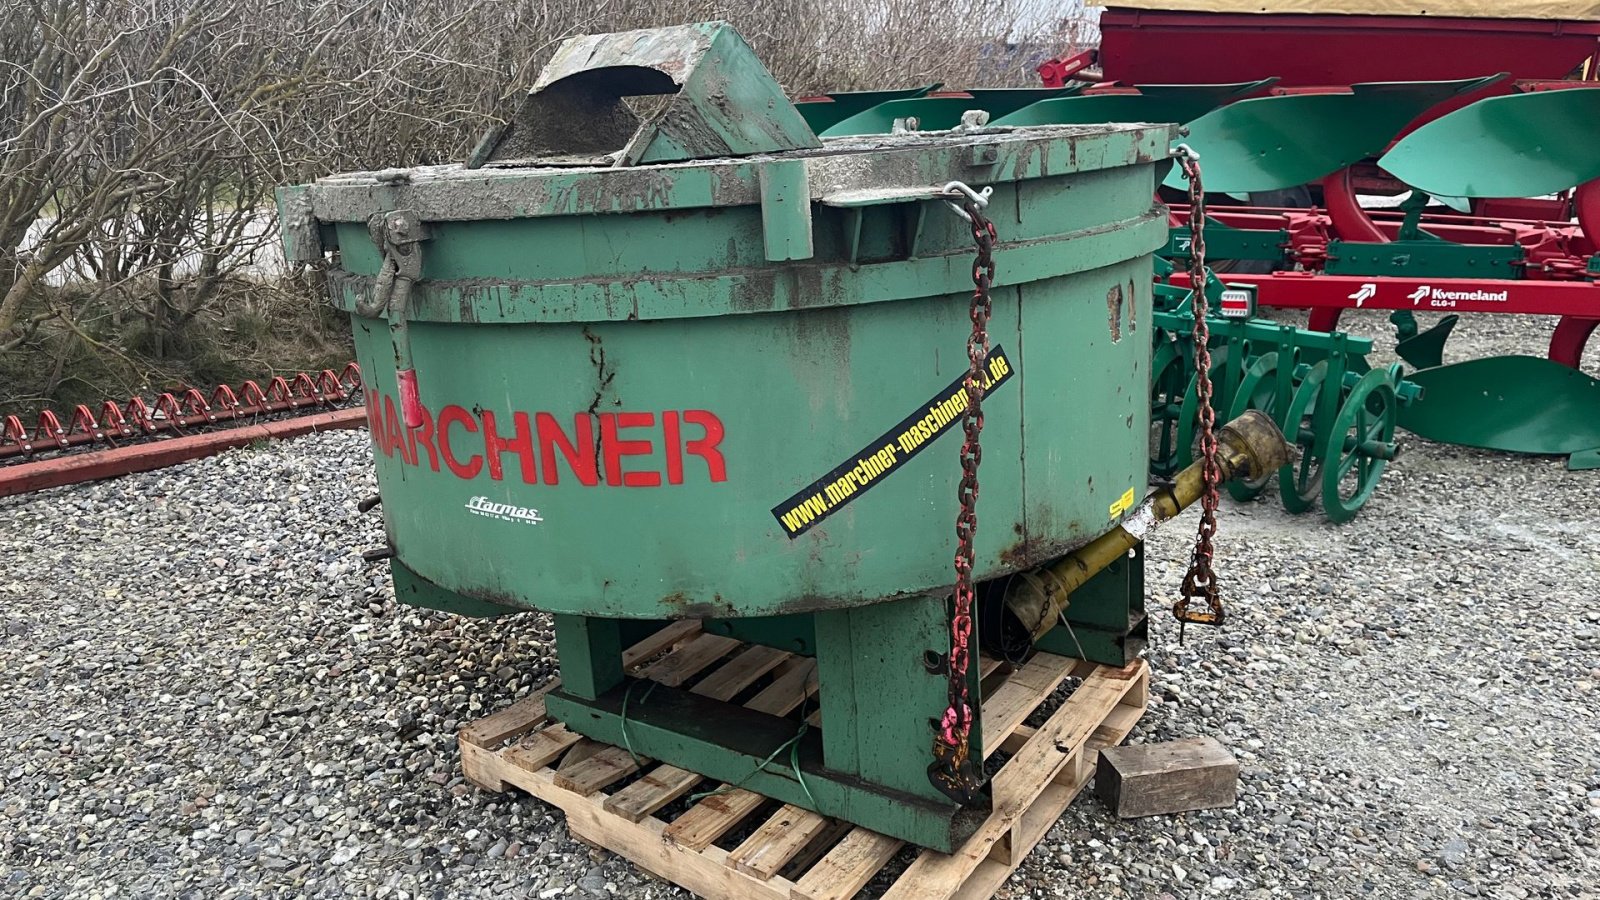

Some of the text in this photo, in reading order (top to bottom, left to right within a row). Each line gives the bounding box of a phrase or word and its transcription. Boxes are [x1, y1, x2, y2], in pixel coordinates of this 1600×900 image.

[1432, 288, 1507, 301] Kverneland
[362, 387, 728, 487] MARCHNER
[476, 496, 538, 518] farmas
